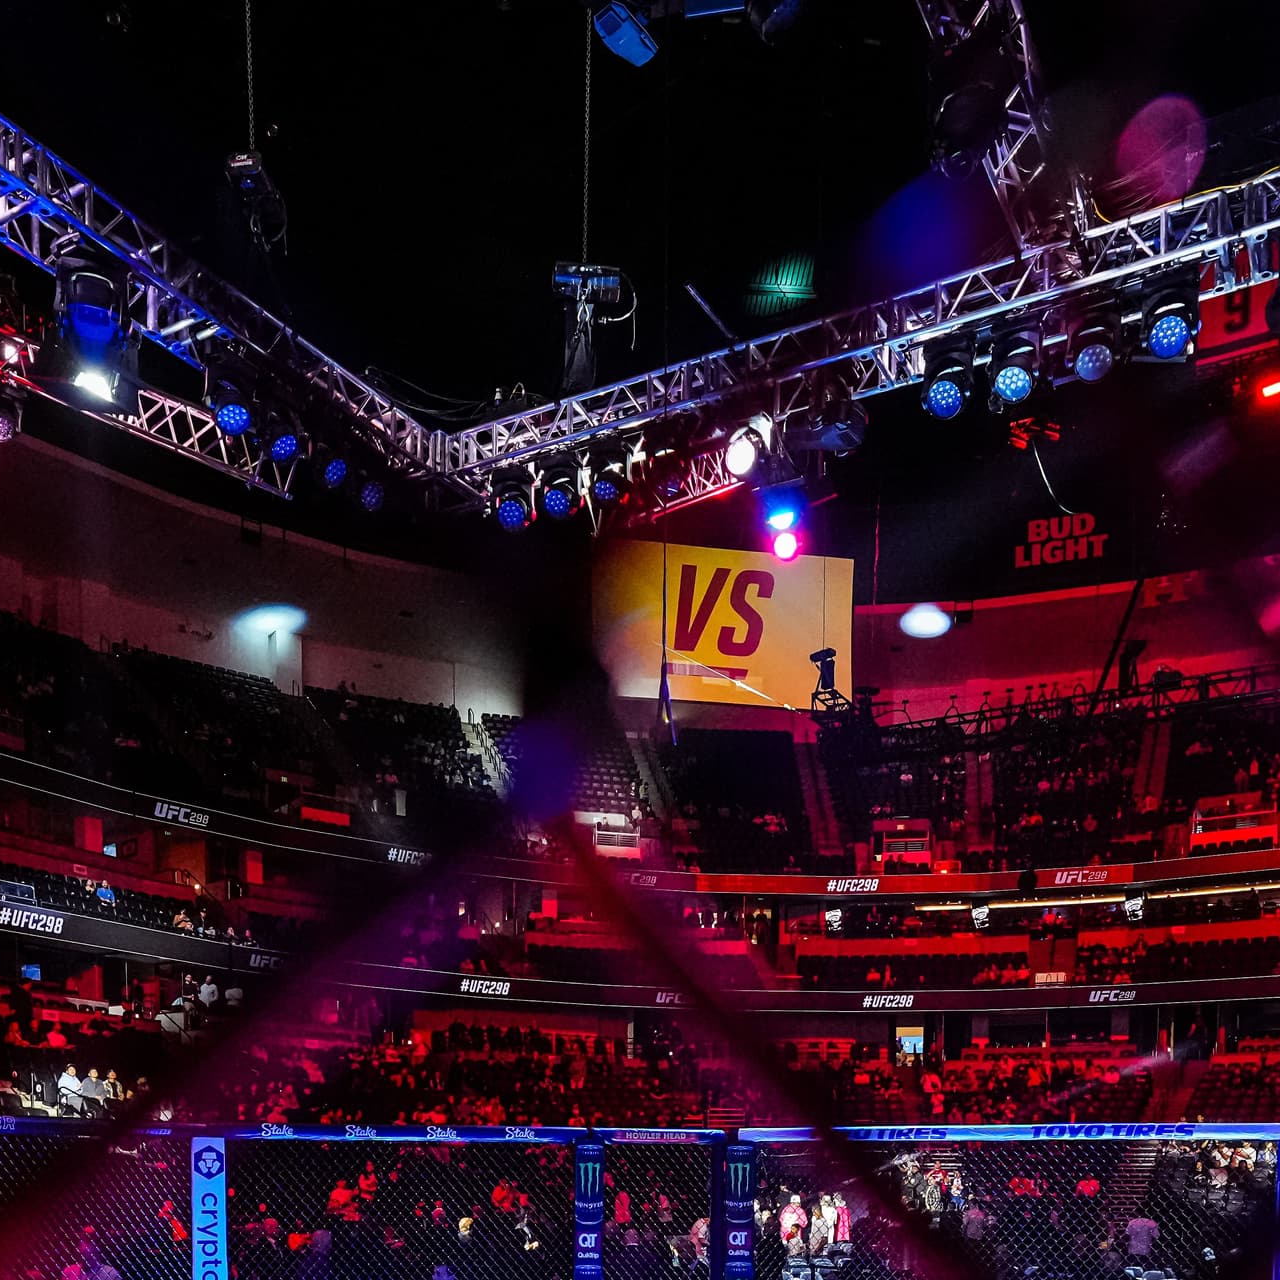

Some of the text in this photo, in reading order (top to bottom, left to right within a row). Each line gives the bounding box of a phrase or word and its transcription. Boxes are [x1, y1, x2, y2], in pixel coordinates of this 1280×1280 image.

[1027, 512, 1094, 543] BUD
[1013, 533, 1109, 568] LIGHT
[672, 564, 773, 657] VS
[826, 879, 879, 893] #UFC298
[460, 978, 510, 996] #UFC298
[862, 995, 914, 1008] #UFC298
[261, 1122, 294, 1138] Stake
[344, 1124, 376, 1139] Stake
[426, 1126, 456, 1140] Stake
[504, 1126, 534, 1140] Stake
[626, 1131, 687, 1140] HOWLER HEAD
[867, 1127, 946, 1140] TIRES
[1031, 1123, 1193, 1139] TOYO TIRES
